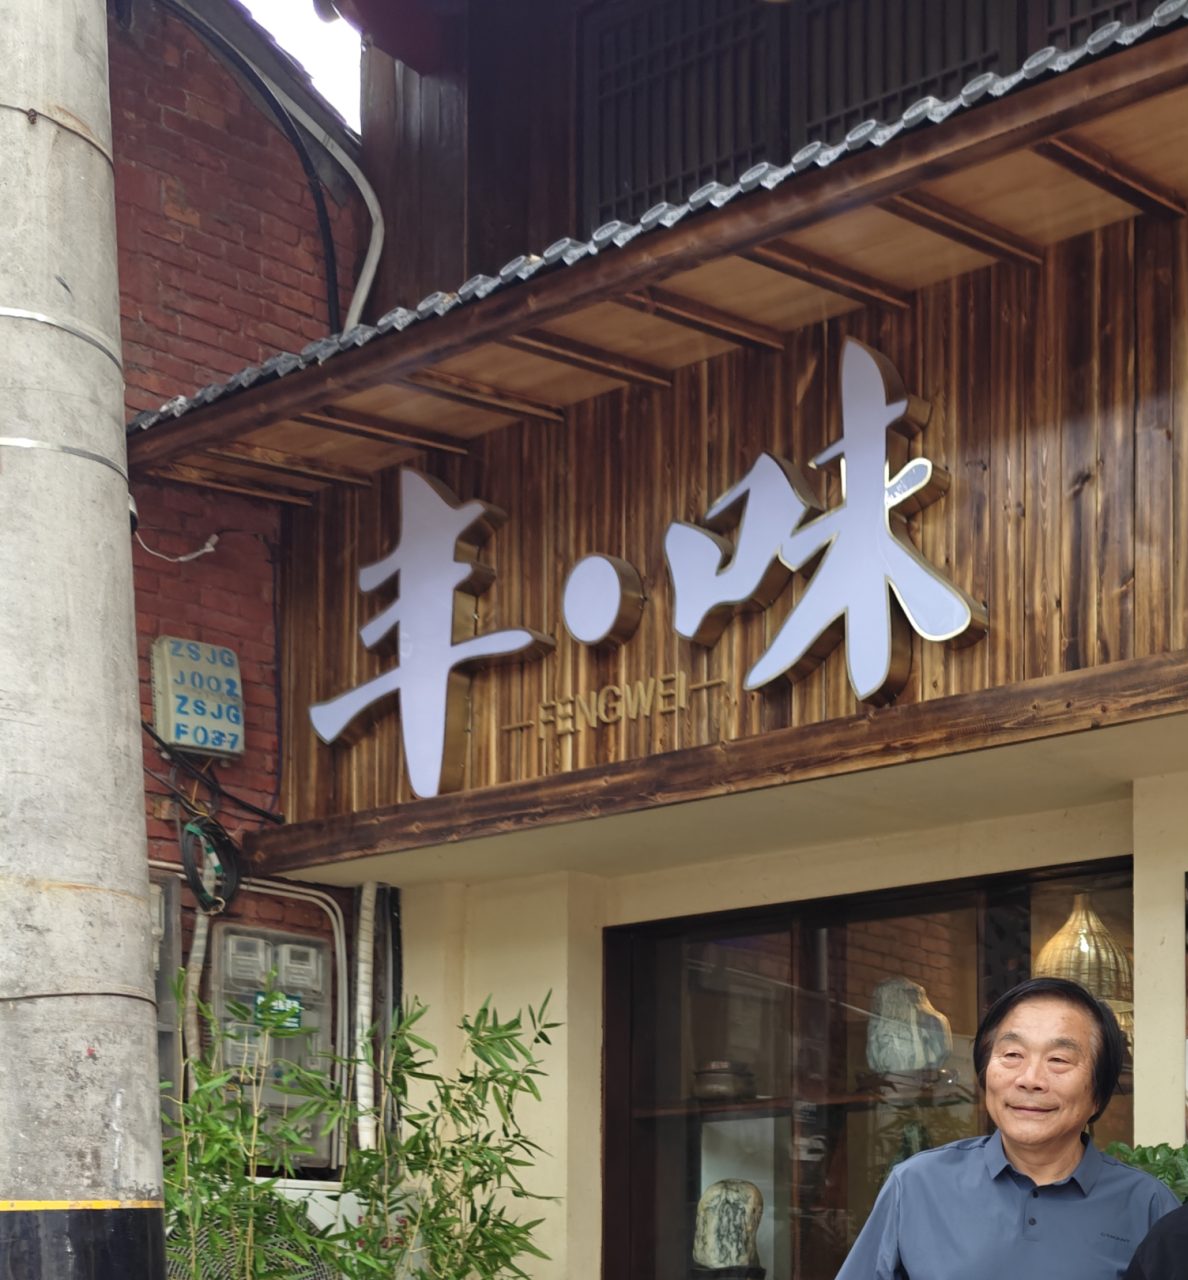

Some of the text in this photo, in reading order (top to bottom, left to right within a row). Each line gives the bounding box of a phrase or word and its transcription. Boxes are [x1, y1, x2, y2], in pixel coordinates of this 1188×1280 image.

[170, 640, 236, 668] ZSJG
[175, 694, 241, 726] ZSJG
[538, 670, 687, 741] FENGWEI
